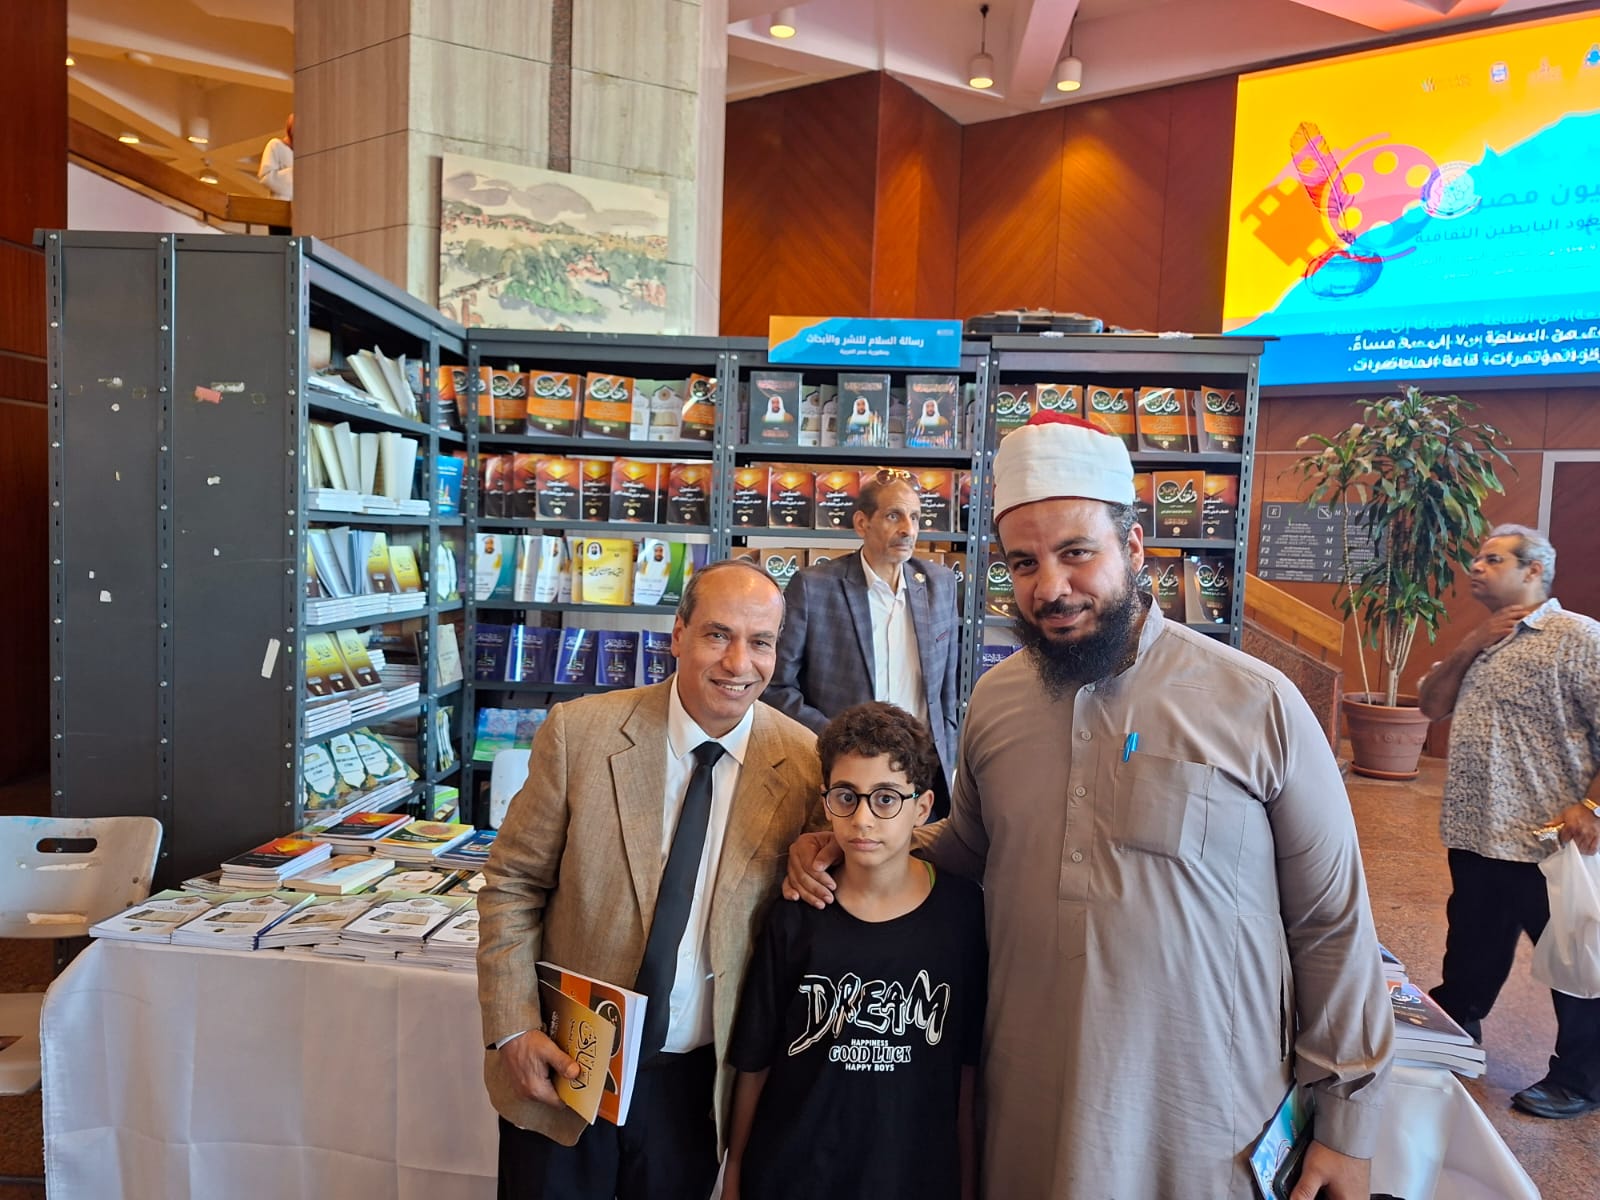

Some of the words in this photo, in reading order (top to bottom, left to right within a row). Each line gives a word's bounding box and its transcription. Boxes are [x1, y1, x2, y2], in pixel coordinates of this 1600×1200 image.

[842, 334, 867, 346] للنشر
[868, 335, 897, 347] السلام
[899, 336, 924, 348] رسالة
[788, 969, 951, 1057] DREAM
[851, 1038, 889, 1047] HAPPINESS
[829, 1046, 871, 1063] GOOD
[872, 1046, 912, 1063] LUCK
[845, 1063, 872, 1071] HAPPY
[874, 1063, 895, 1072] BOYS
